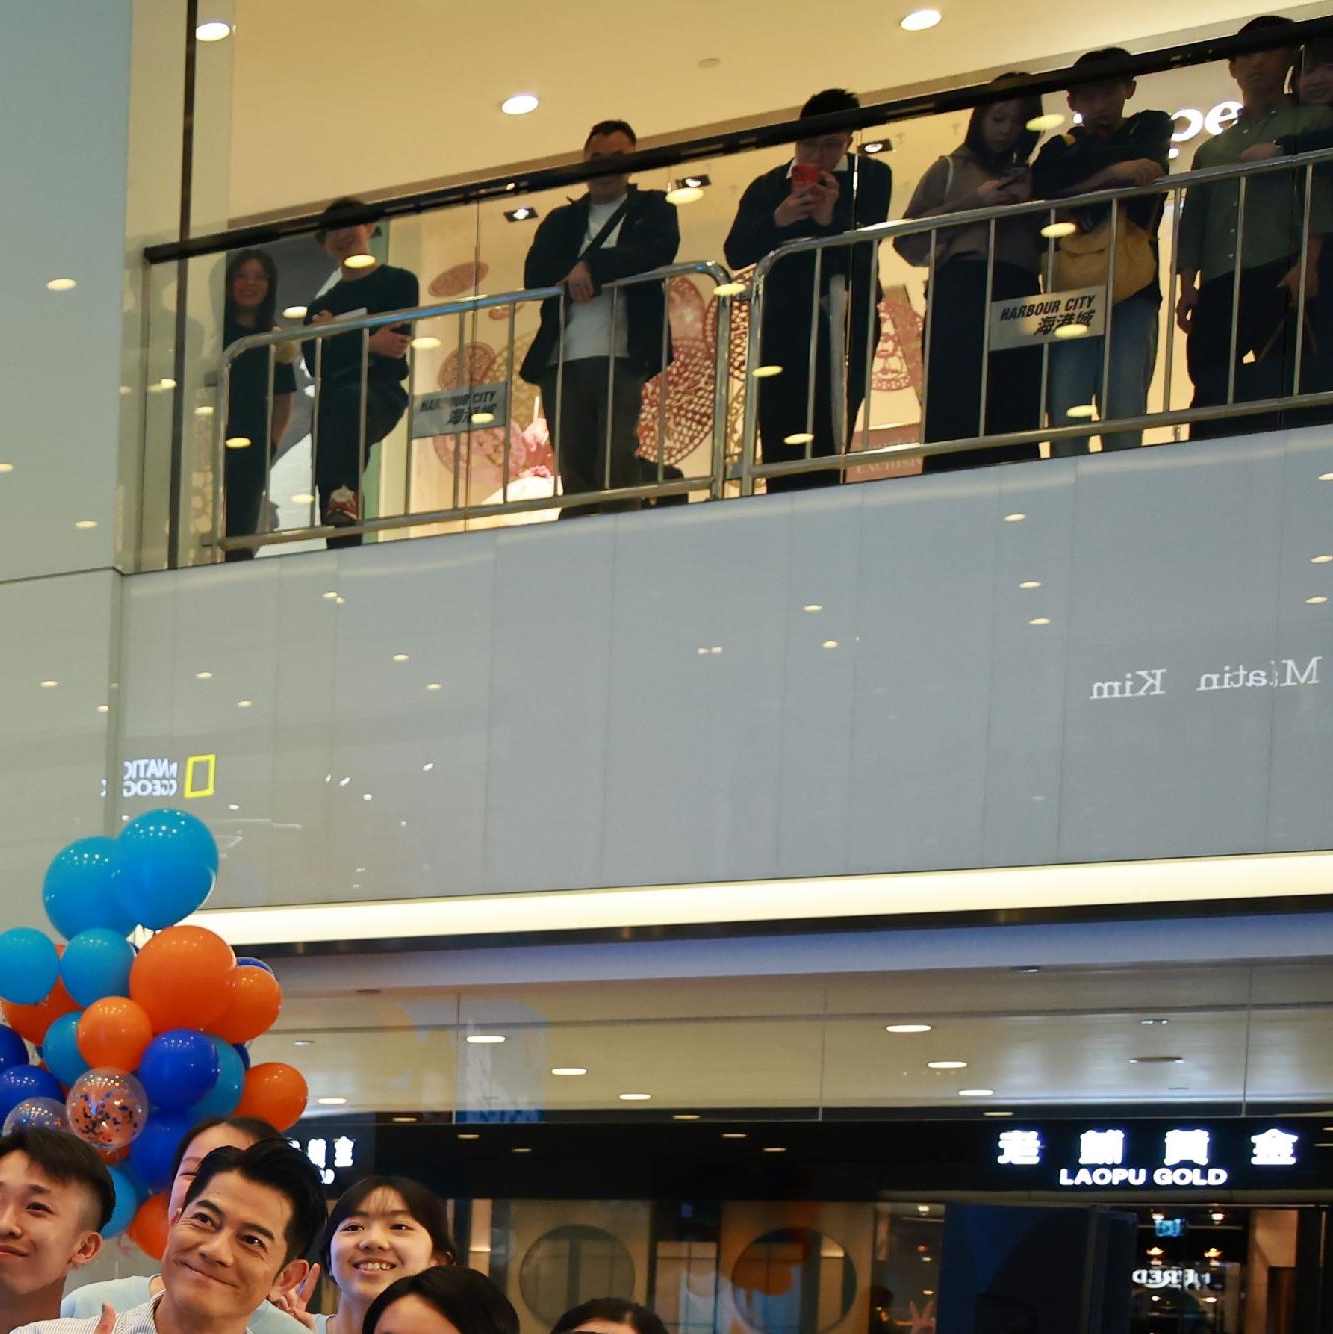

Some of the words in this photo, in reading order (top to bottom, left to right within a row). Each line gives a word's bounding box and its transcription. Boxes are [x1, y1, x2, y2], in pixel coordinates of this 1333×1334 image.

[1000, 300, 1061, 321] HARBOUR
[1065, 295, 1096, 312] CITY
[1059, 1168, 1147, 1186] LAOPU
[1153, 1168, 1229, 1186] GOLD
